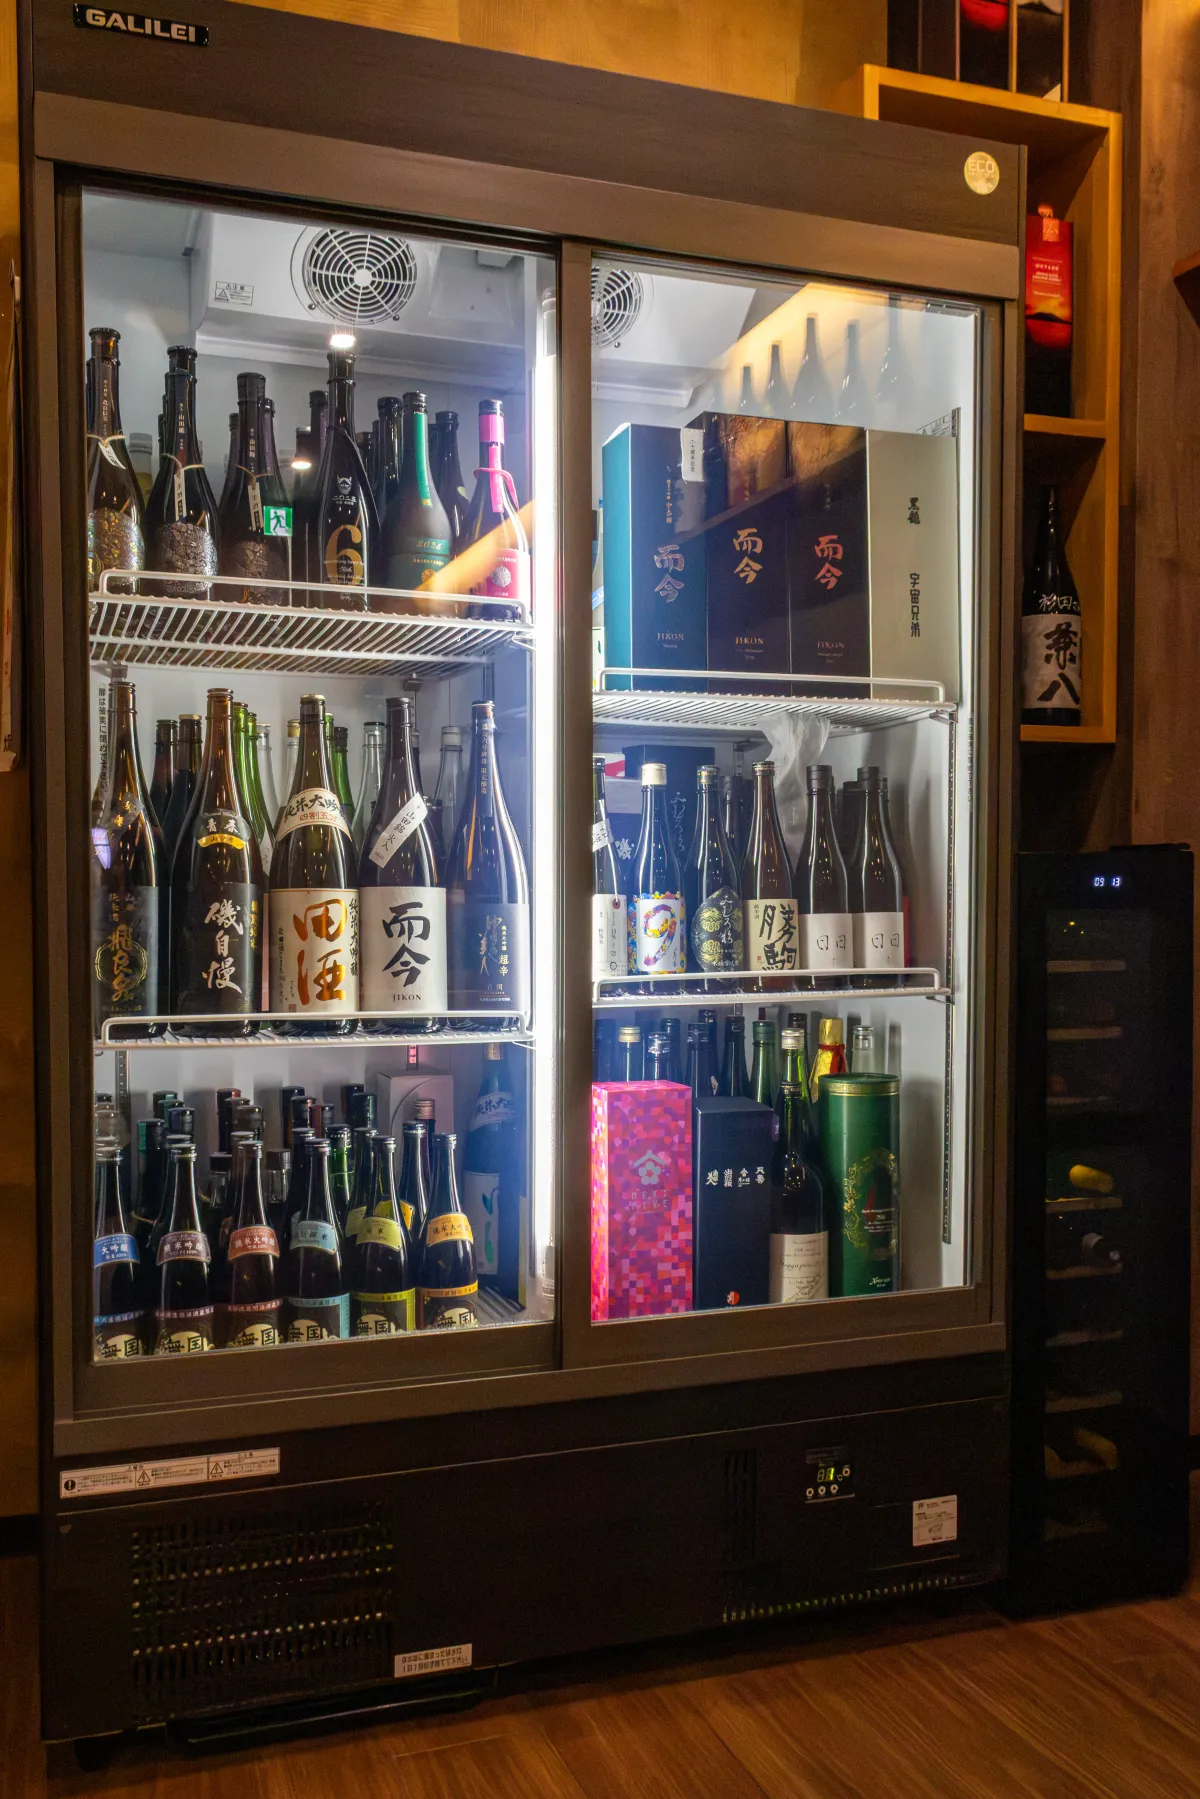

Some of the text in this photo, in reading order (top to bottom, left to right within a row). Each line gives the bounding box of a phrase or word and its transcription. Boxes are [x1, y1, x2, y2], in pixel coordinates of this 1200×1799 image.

[85, 8, 196, 42] GALILEI
[968, 160, 995, 173] ECO
[653, 544, 685, 603] 而今
[732, 527, 763, 585] 而今
[814, 534, 844, 590] 而今
[909, 572, 921, 638] 宇宙兄弟
[735, 636, 764, 645] JIKON
[1037, 622, 1080, 705] 兼八
[381, 811, 415, 852] 山田錦 火入
[202, 899, 244, 994] 磯自慢
[292, 898, 348, 1006] 田酒
[382, 901, 431, 988] 而今
[644, 904, 677, 966] 9
[759, 903, 797, 971] 勝駒
[498, 954, 510, 976] 超辛
[393, 993, 422, 1002] JIKON
[631, 1190, 668, 1200] NEXT
[101, 1243, 129, 1254] 大吟醸
